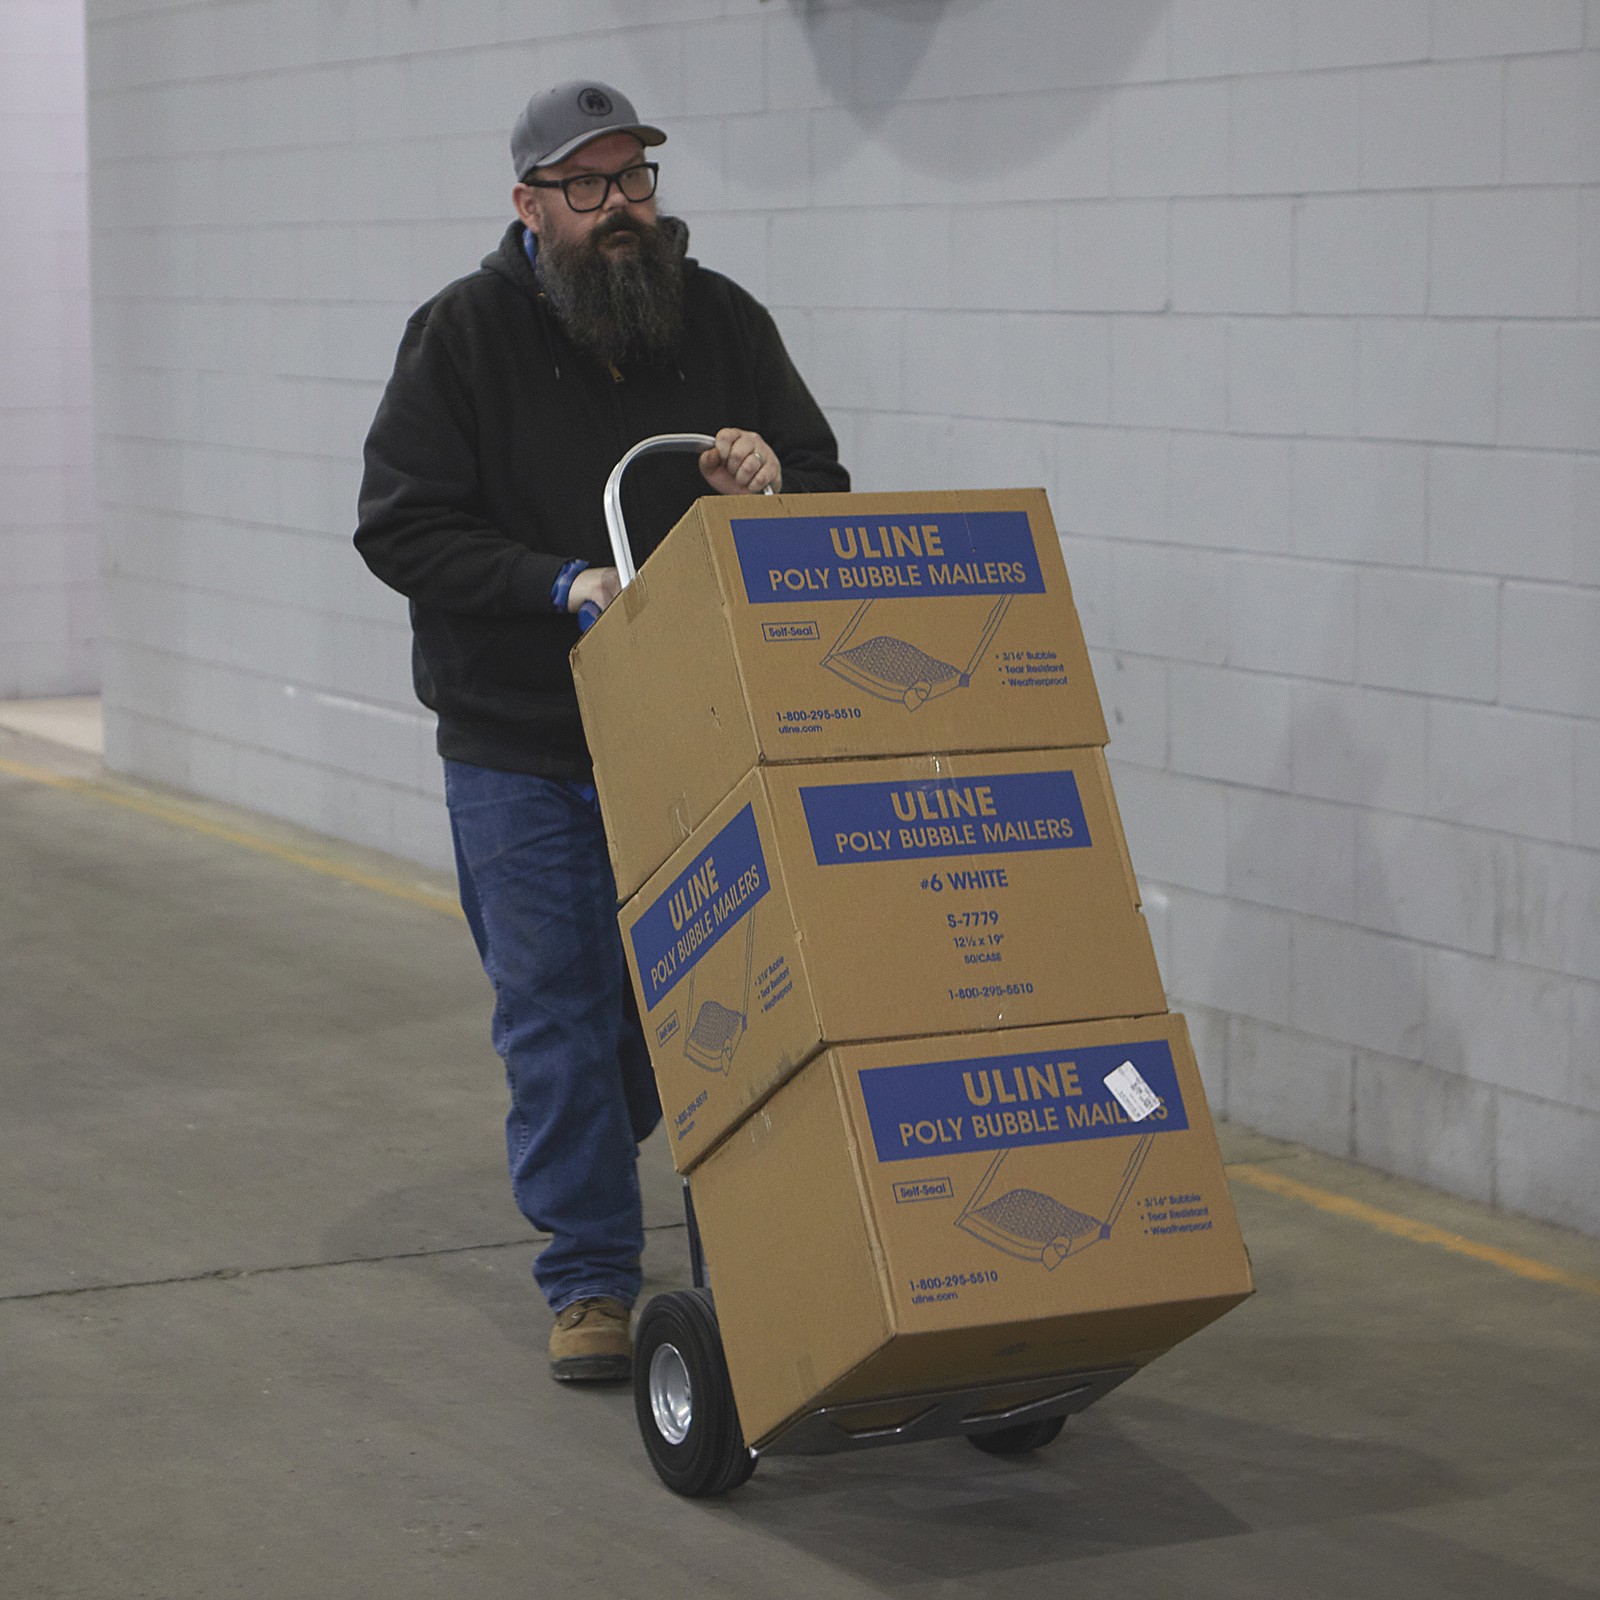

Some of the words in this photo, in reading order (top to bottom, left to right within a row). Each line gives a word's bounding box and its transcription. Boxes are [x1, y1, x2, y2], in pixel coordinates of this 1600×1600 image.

[829, 525, 945, 560] ULINE
[769, 568, 830, 592] POLY
[838, 564, 922, 588] BUBBLE
[927, 561, 1026, 585] MAILERS
[769, 626, 813, 637] Self-Seal
[1008, 676, 1068, 687] Weatherproof
[776, 708, 861, 722] 1-800-295-5510
[778, 724, 823, 734] uline.com
[891, 785, 997, 822] ULINE
[835, 830, 893, 854] POLY
[899, 823, 976, 849] BUBBLE
[981, 818, 1073, 843] MAILERS
[920, 873, 943, 892] #6
[946, 868, 1009, 890] WHITE
[668, 856, 720, 931] ULINE
[650, 946, 677, 991] POLY
[677, 910, 713, 963] BUBBLE
[712, 864, 760, 926] MAILERS
[947, 910, 999, 928] S-7779
[948, 982, 1034, 1000] 1-800-295-5510
[962, 1061, 1083, 1107] ULINE
[899, 1117, 964, 1147] POLY
[972, 1107, 1060, 1139] BUBBLE
[1065, 1096, 1169, 1129] MAILS
[900, 1183, 946, 1198] Self-Seal
[909, 1270, 998, 1292] 1-800-295-5510
